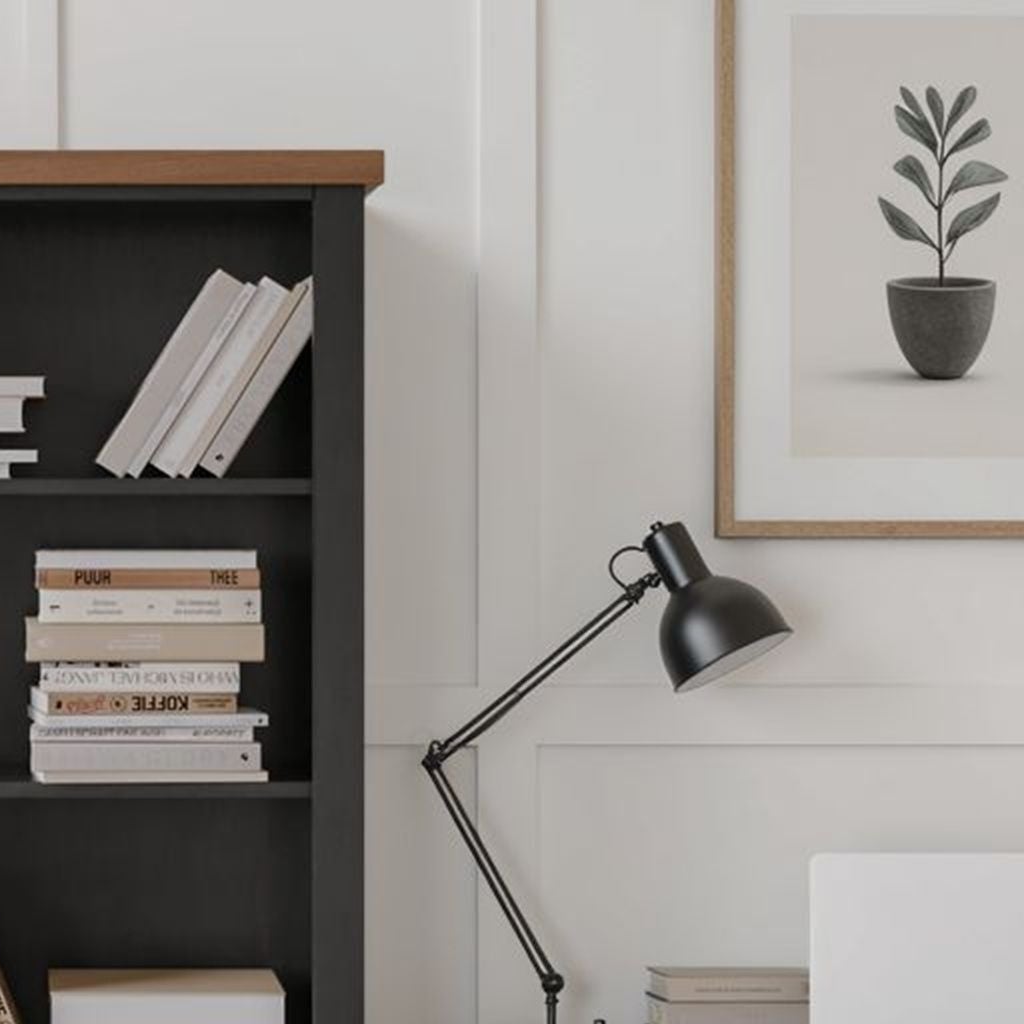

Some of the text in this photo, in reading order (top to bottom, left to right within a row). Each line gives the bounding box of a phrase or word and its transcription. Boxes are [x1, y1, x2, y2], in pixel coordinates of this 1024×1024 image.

[74, 569, 239, 585] PUUR THEE
[131, 696, 189, 711] KOFFIE
